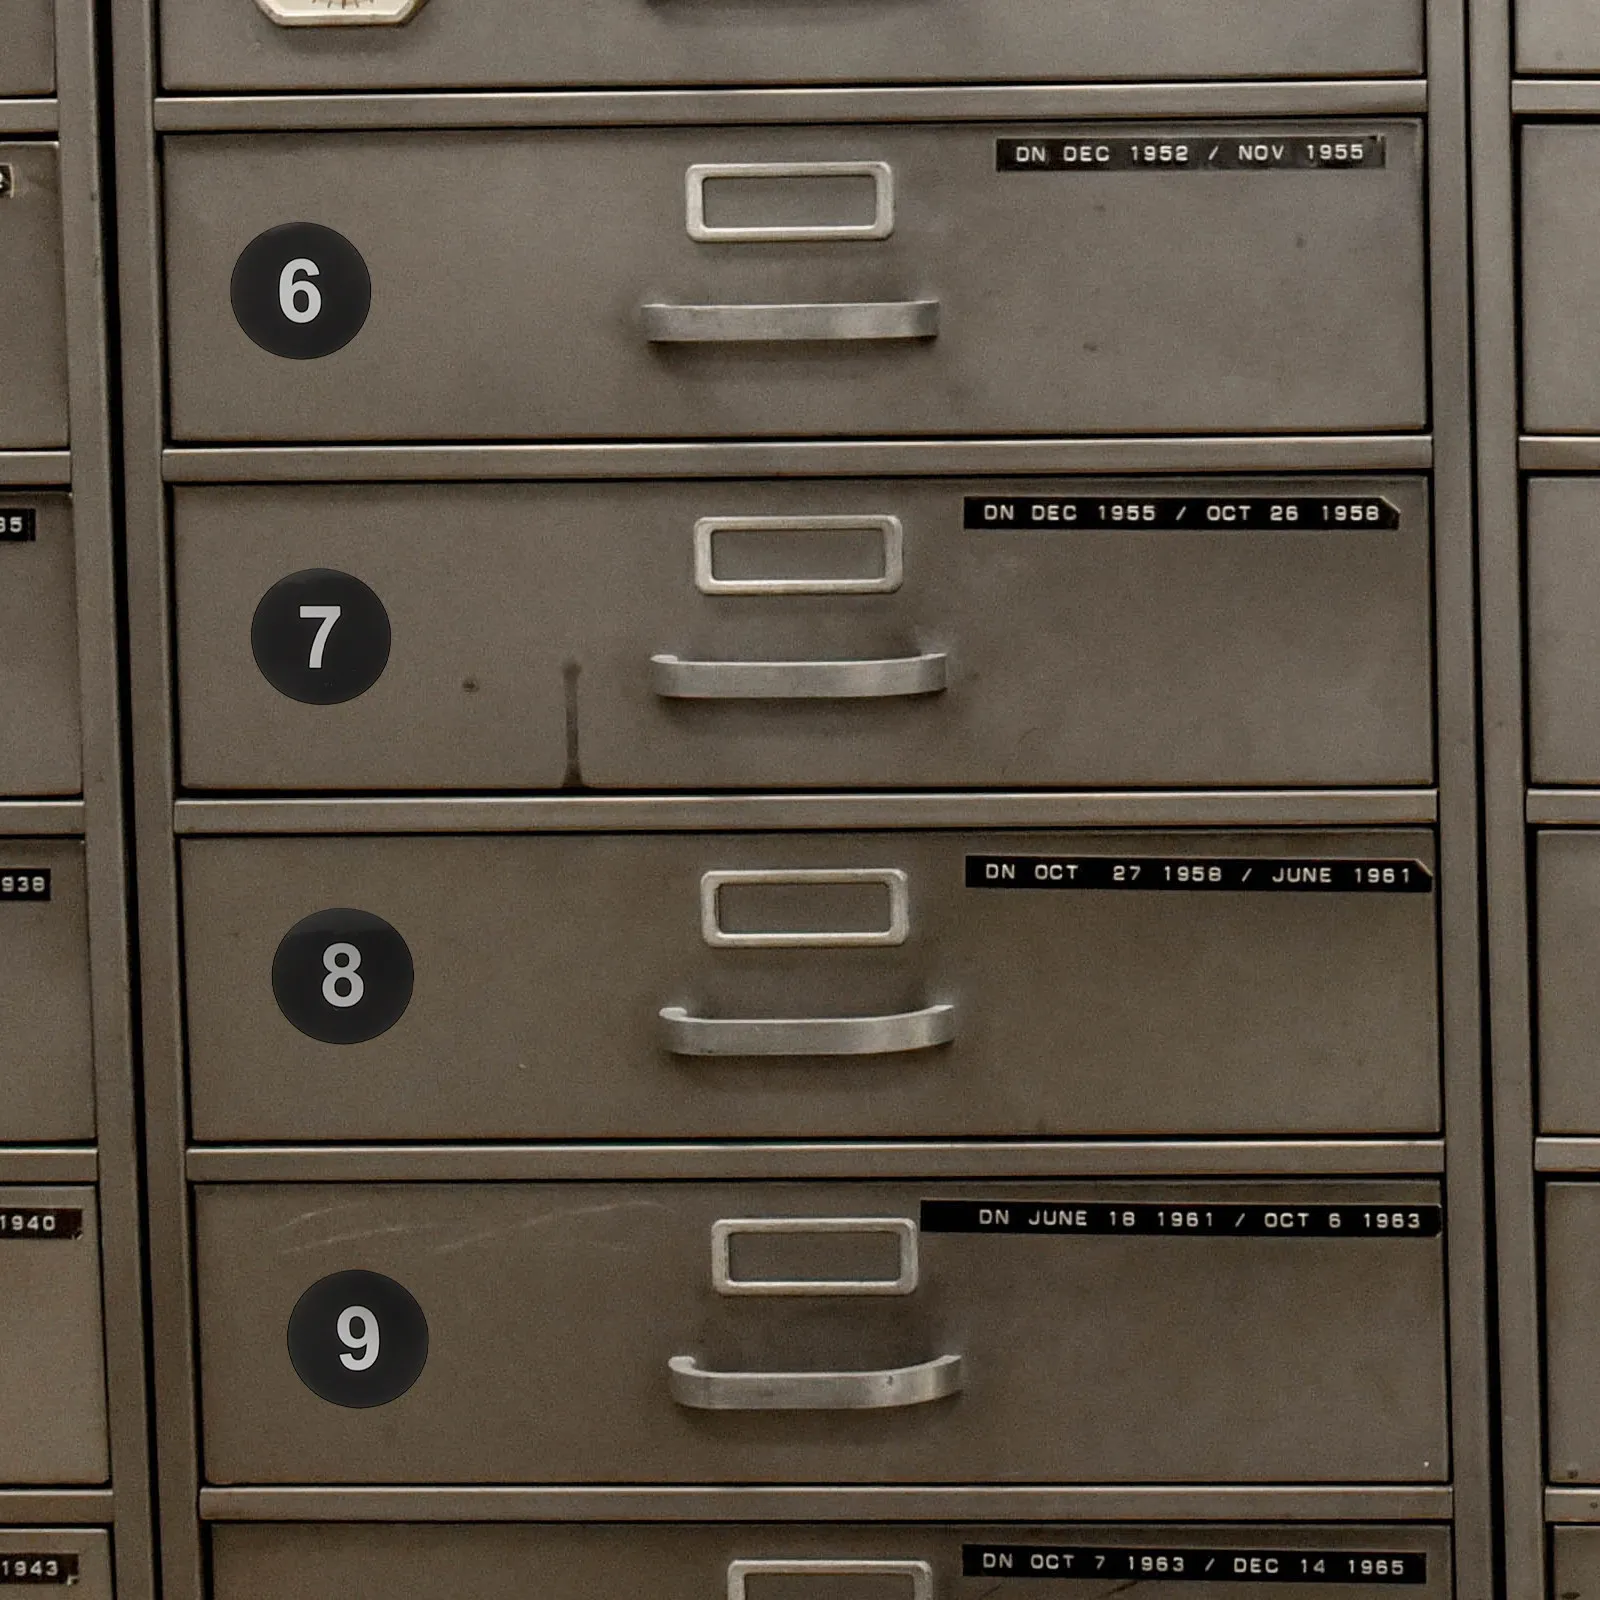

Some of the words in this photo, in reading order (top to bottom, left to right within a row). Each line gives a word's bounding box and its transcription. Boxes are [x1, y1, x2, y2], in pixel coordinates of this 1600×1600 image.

[1016, 145, 1046, 163] DN
[1063, 145, 1110, 162] DEC
[1130, 144, 1189, 162] 1952
[1238, 144, 1285, 161] NOV
[1306, 143, 1364, 160] 1955
[279, 258, 322, 324] 6
[984, 504, 1014, 521] DN
[1031, 504, 1077, 521] DEC
[1096, 504, 1155, 521] 1955
[1206, 505, 1251, 521] OCT
[1270, 505, 1299, 522] 26
[1321, 505, 1379, 521] 1958
[299, 605, 341, 669] 7
[985, 863, 1015, 879] DN
[1034, 864, 1079, 880] OCT
[1112, 865, 1141, 881] 27
[1163, 865, 1222, 882] 1958
[1272, 867, 1332, 883] JUNE
[1354, 867, 1409, 884] 1961
[322, 942, 364, 1008] 8
[0, 1215, 56, 1231] 1940
[979, 1209, 1009, 1225] DN
[1028, 1210, 1087, 1226] JUNE
[1156, 1211, 1212, 1227] 1961
[1264, 1212, 1309, 1228] OCT
[1328, 1212, 1341, 1228] 6
[1363, 1212, 1420, 1229] 1963
[337, 1305, 380, 1371] 9
[1, 1560, 58, 1576] 1943
[983, 1552, 1012, 1569] DN
[1030, 1554, 1074, 1570] OCT
[1093, 1555, 1106, 1570] 7
[1128, 1555, 1184, 1572] 1963
[1233, 1557, 1279, 1574] DEC
[1300, 1558, 1325, 1574] 14
[1347, 1559, 1404, 1575] 1965
